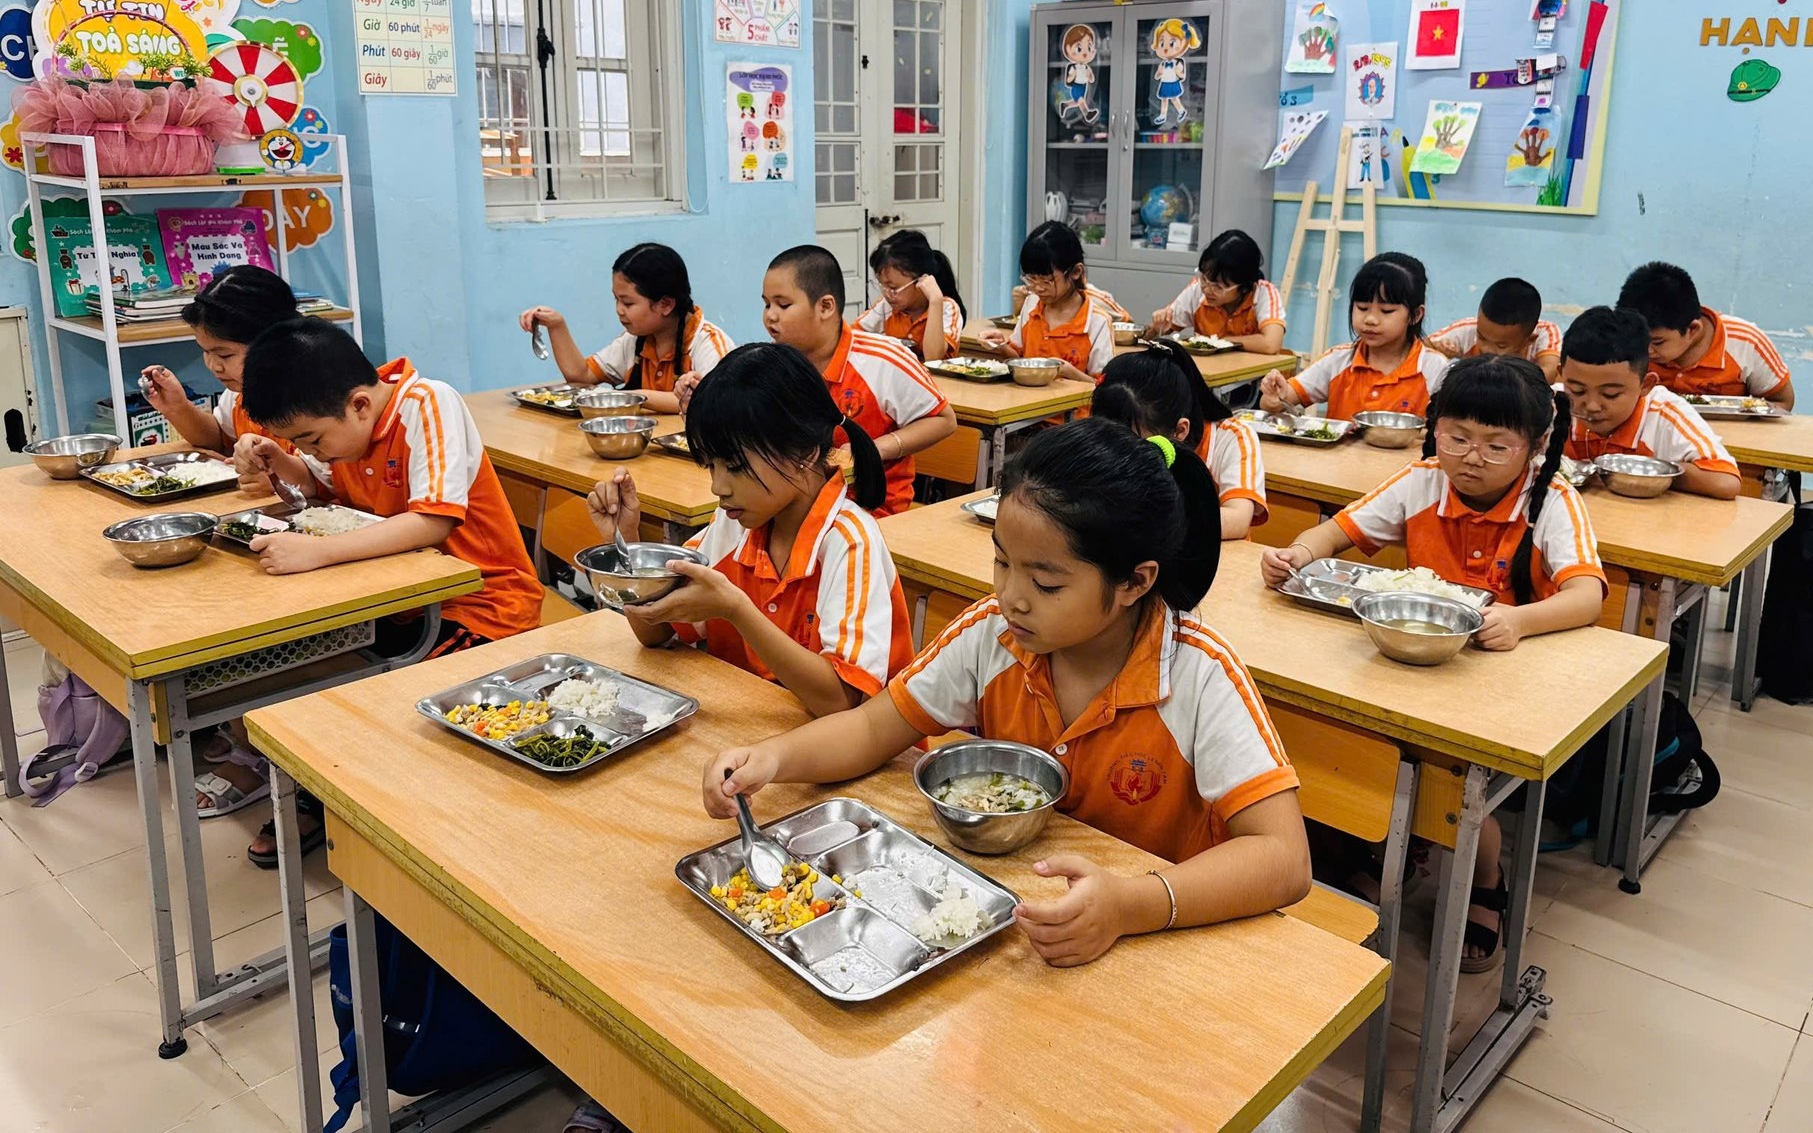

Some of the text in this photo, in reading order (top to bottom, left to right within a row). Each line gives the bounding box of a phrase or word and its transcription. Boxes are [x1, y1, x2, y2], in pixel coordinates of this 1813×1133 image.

[363, 18, 381, 31] Giờ
[388, 22, 399, 32] 60
[401, 22, 420, 34] phút
[748, 24, 754, 40] 5
[126, 29, 182, 55] SÁNG
[362, 44, 386, 57] Phút
[391, 47, 402, 58] 60
[403, 48, 421, 60] giây
[364, 72, 387, 87] Giây
[1290, 95, 1298, 106] 3
